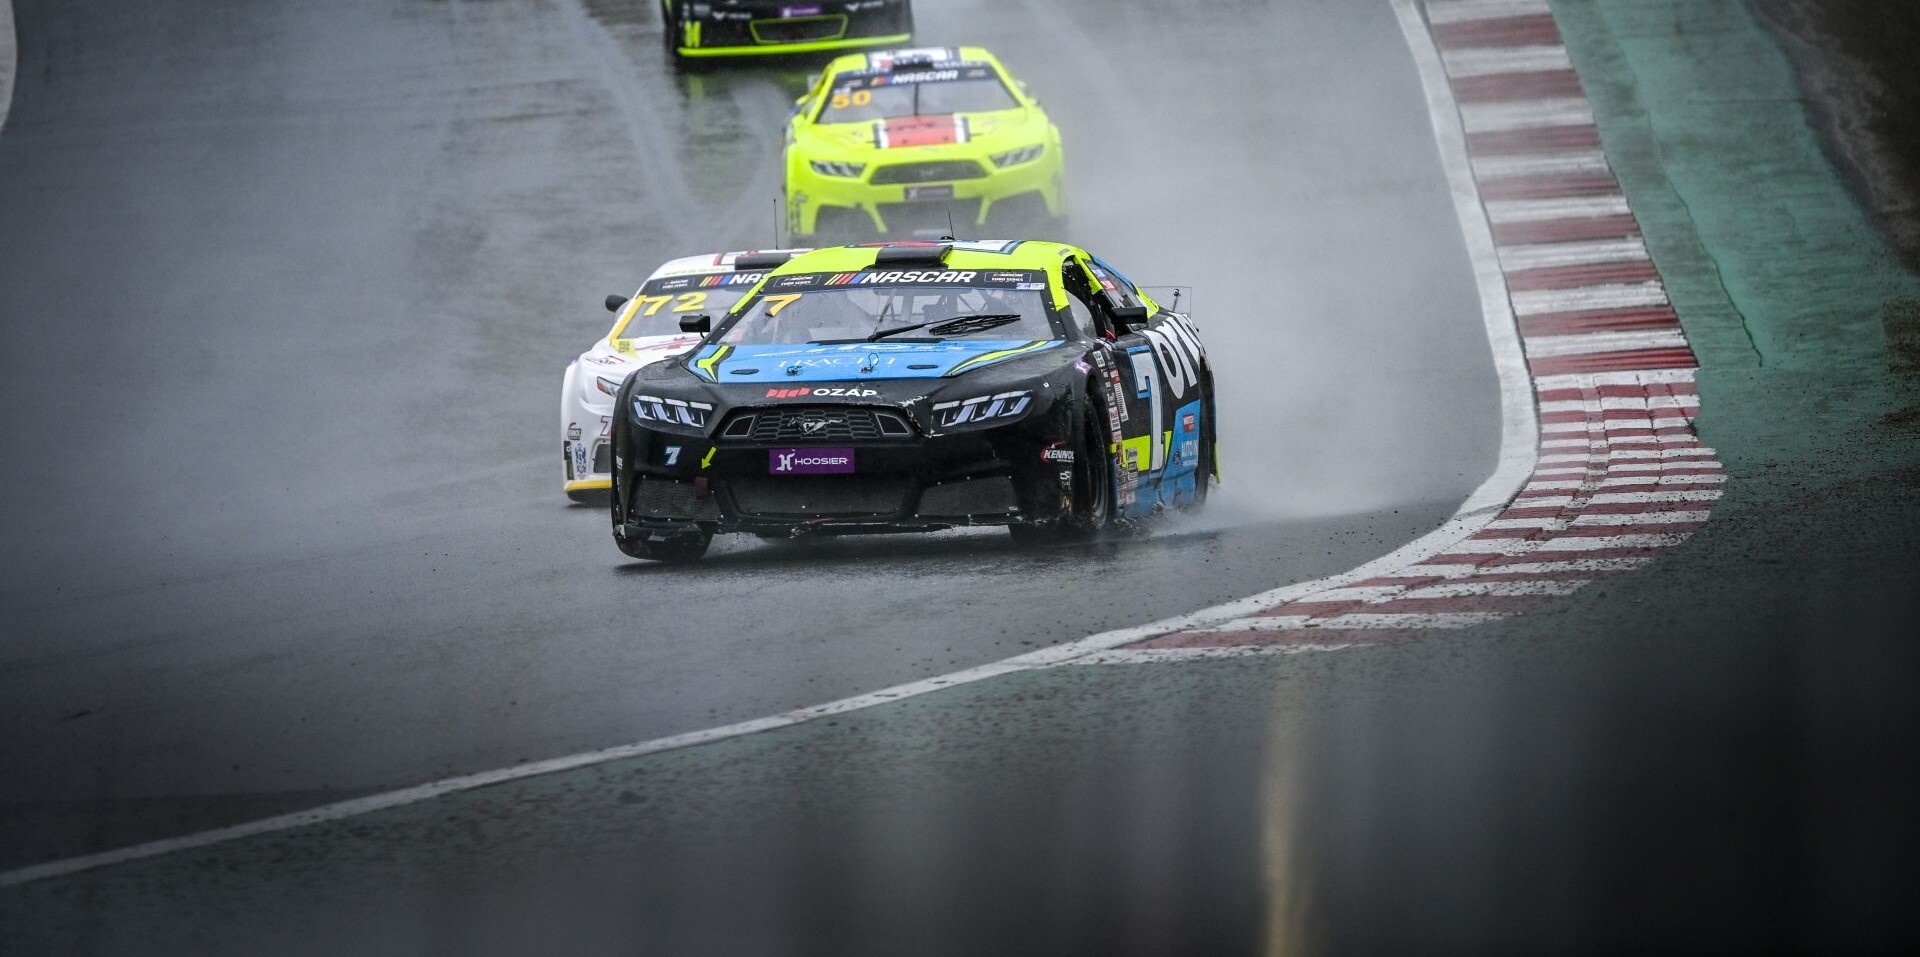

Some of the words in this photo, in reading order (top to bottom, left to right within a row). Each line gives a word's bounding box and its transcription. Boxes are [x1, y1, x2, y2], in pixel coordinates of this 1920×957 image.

[892, 69, 959, 84] NASCAR
[831, 89, 873, 109] 50
[729, 273, 769, 285] NA
[860, 271, 977, 284] NASCAR
[641, 291, 709, 317] 72
[762, 293, 803, 317] 7
[812, 388, 878, 398] OZAP
[1127, 344, 1166, 476] 7
[664, 445, 682, 466] 7
[794, 456, 849, 466] HOOSIER
[1043, 449, 1075, 460] KENNOL
